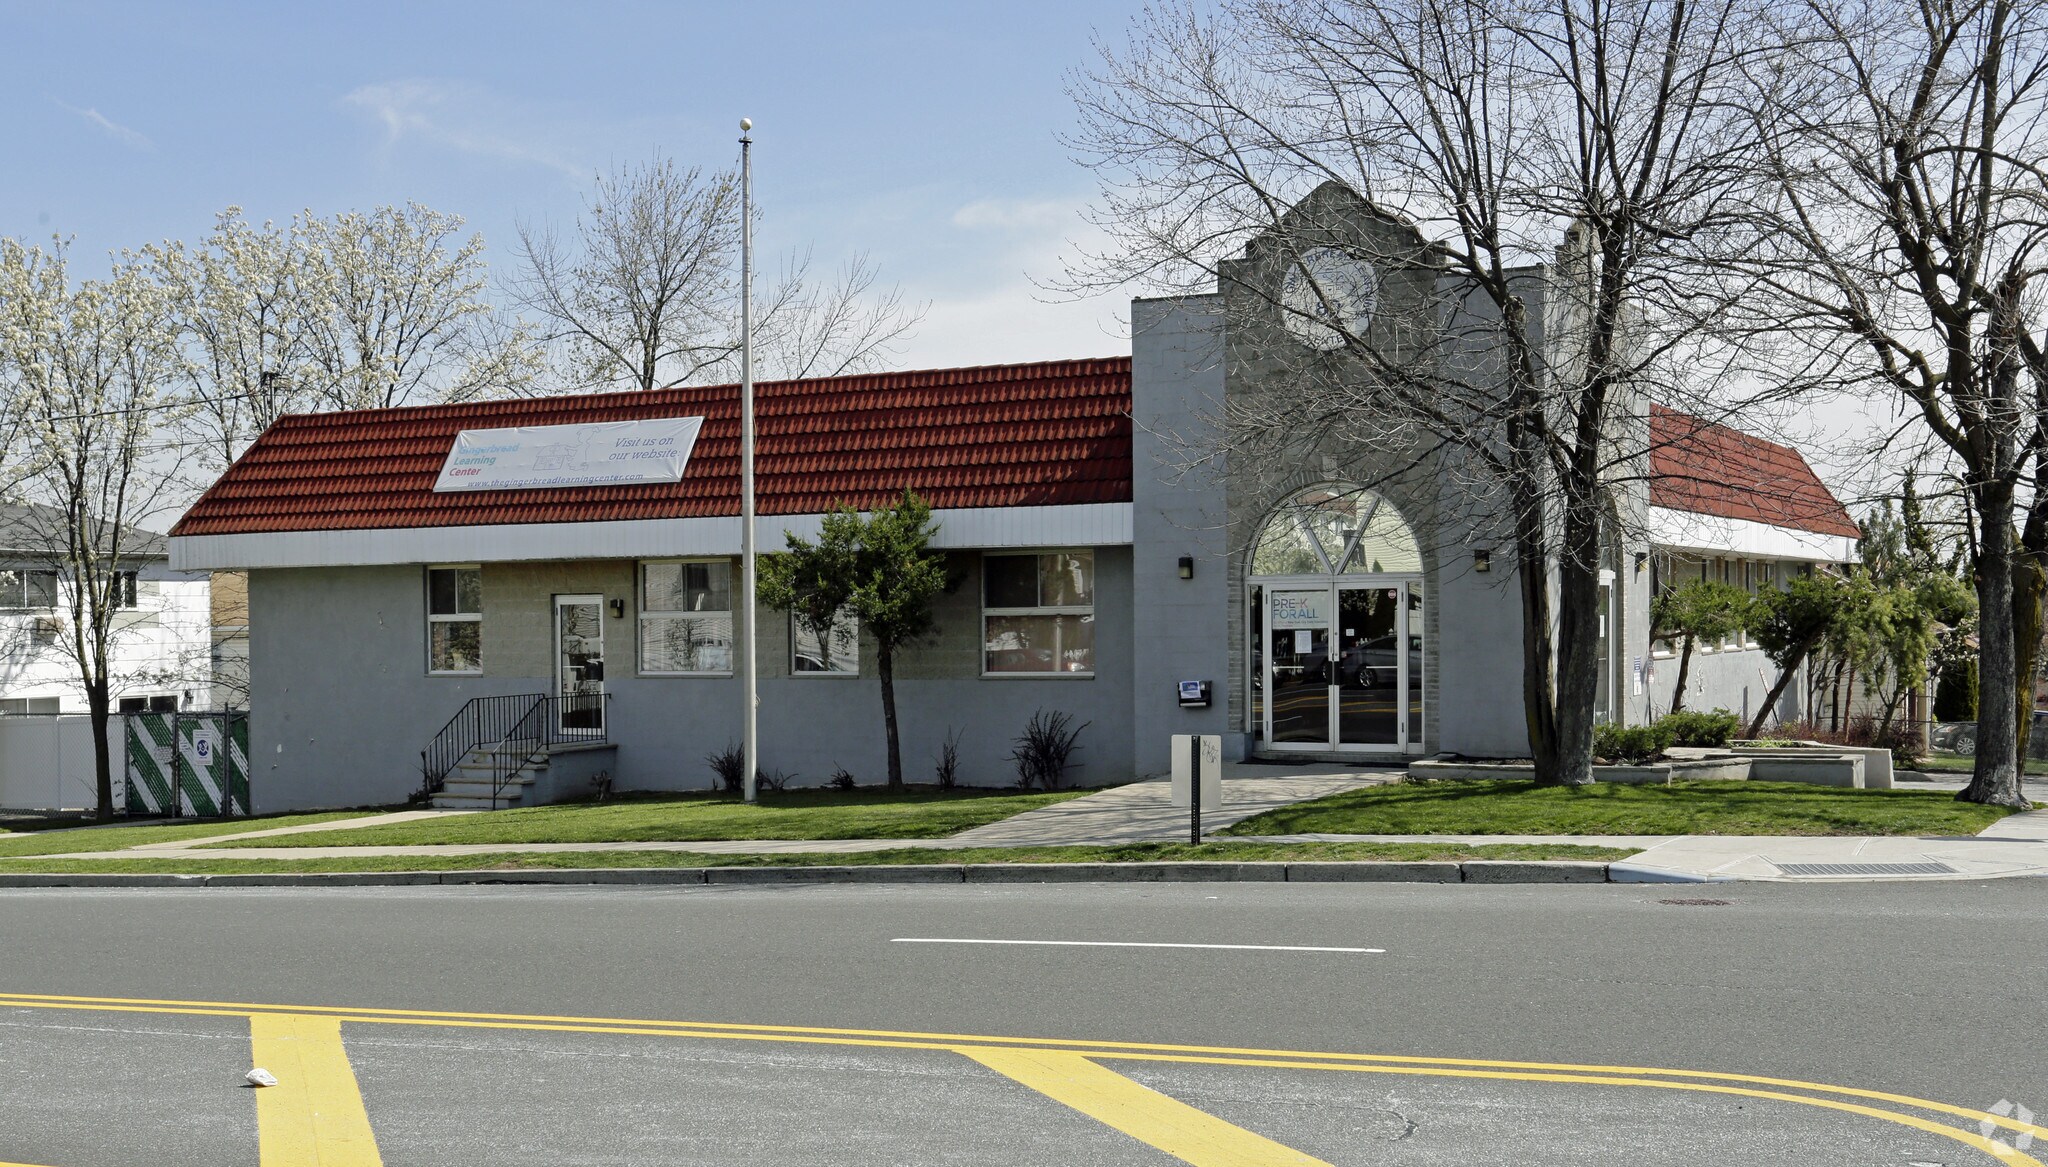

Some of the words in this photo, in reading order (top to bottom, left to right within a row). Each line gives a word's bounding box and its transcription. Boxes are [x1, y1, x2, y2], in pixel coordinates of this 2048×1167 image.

[615, 437, 642, 448] Visit
[642, 438, 657, 446] us
[658, 437, 674, 446] on
[459, 443, 520, 455] Gingerbread
[608, 452, 630, 460] our
[632, 448, 680, 459] website:
[453, 456, 497, 466] Learning
[449, 467, 481, 476] Center
[467, 474, 644, 487] www.thegingerbreadlearningcenter.com
[1273, 598, 1308, 609] PRE-K
[1273, 609, 1297, 619] FOR
[1298, 608, 1319, 619] ALL
